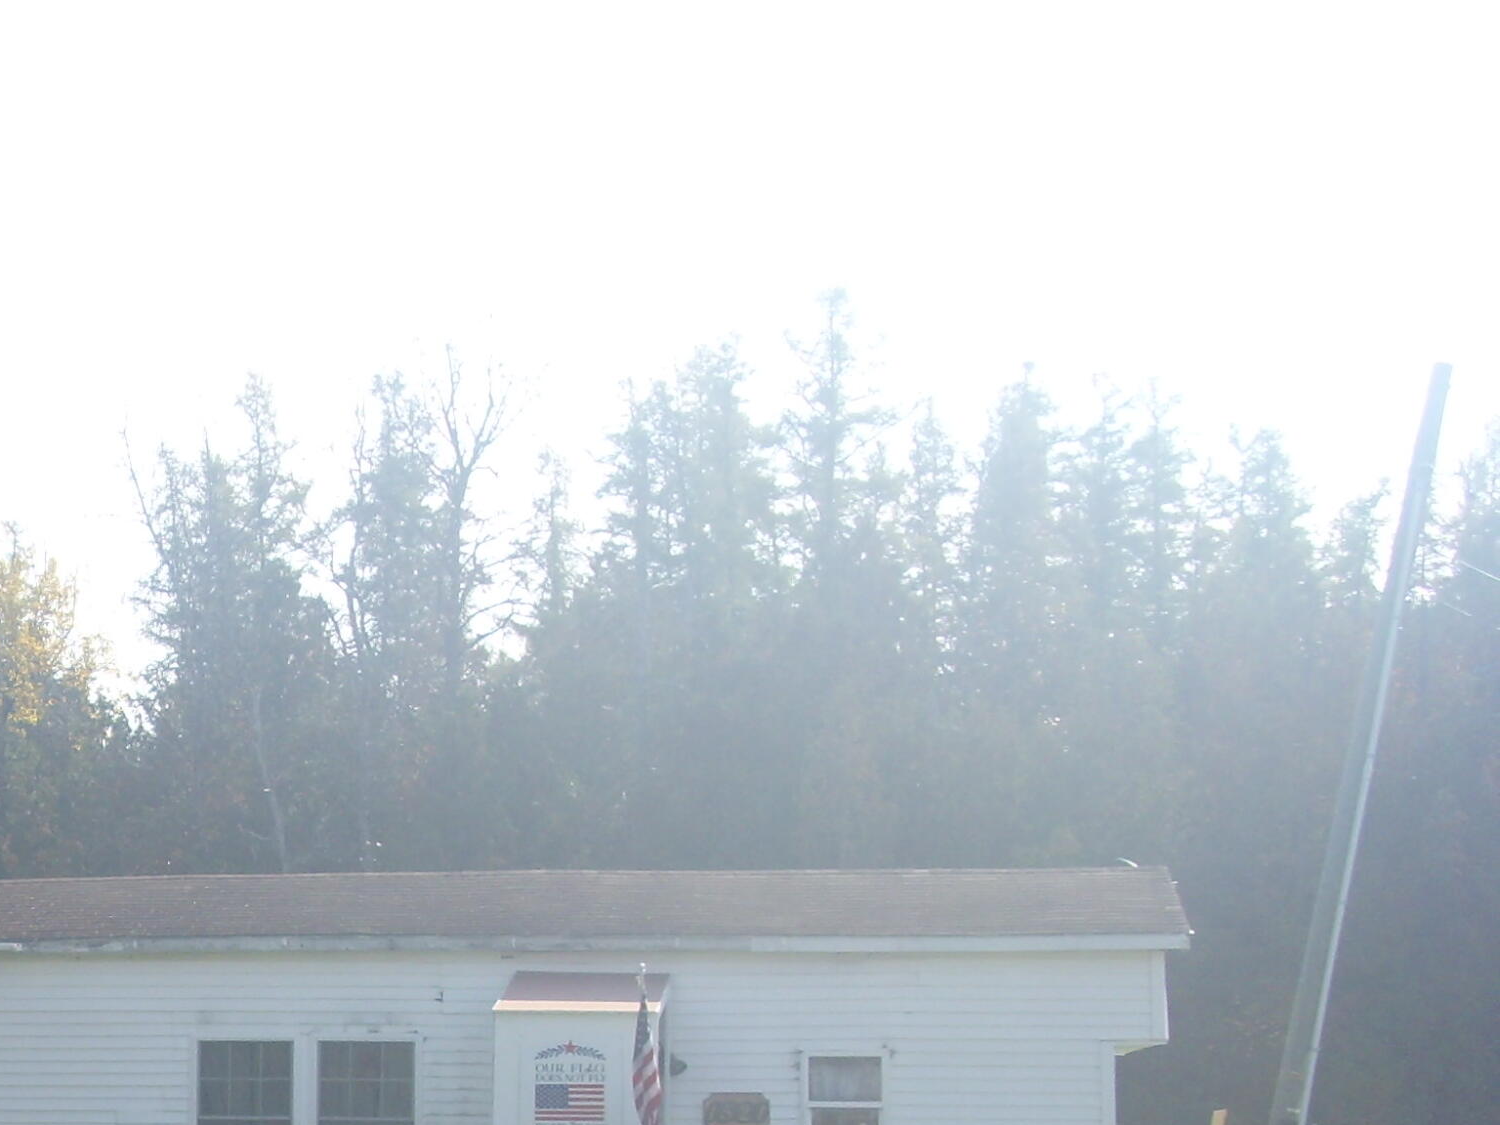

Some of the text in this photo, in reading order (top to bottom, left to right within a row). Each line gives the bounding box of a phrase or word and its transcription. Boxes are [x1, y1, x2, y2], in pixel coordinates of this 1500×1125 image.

[535, 1063, 605, 1073] OUR FLAG
[535, 1073, 606, 1082] DOES NOT FLY
